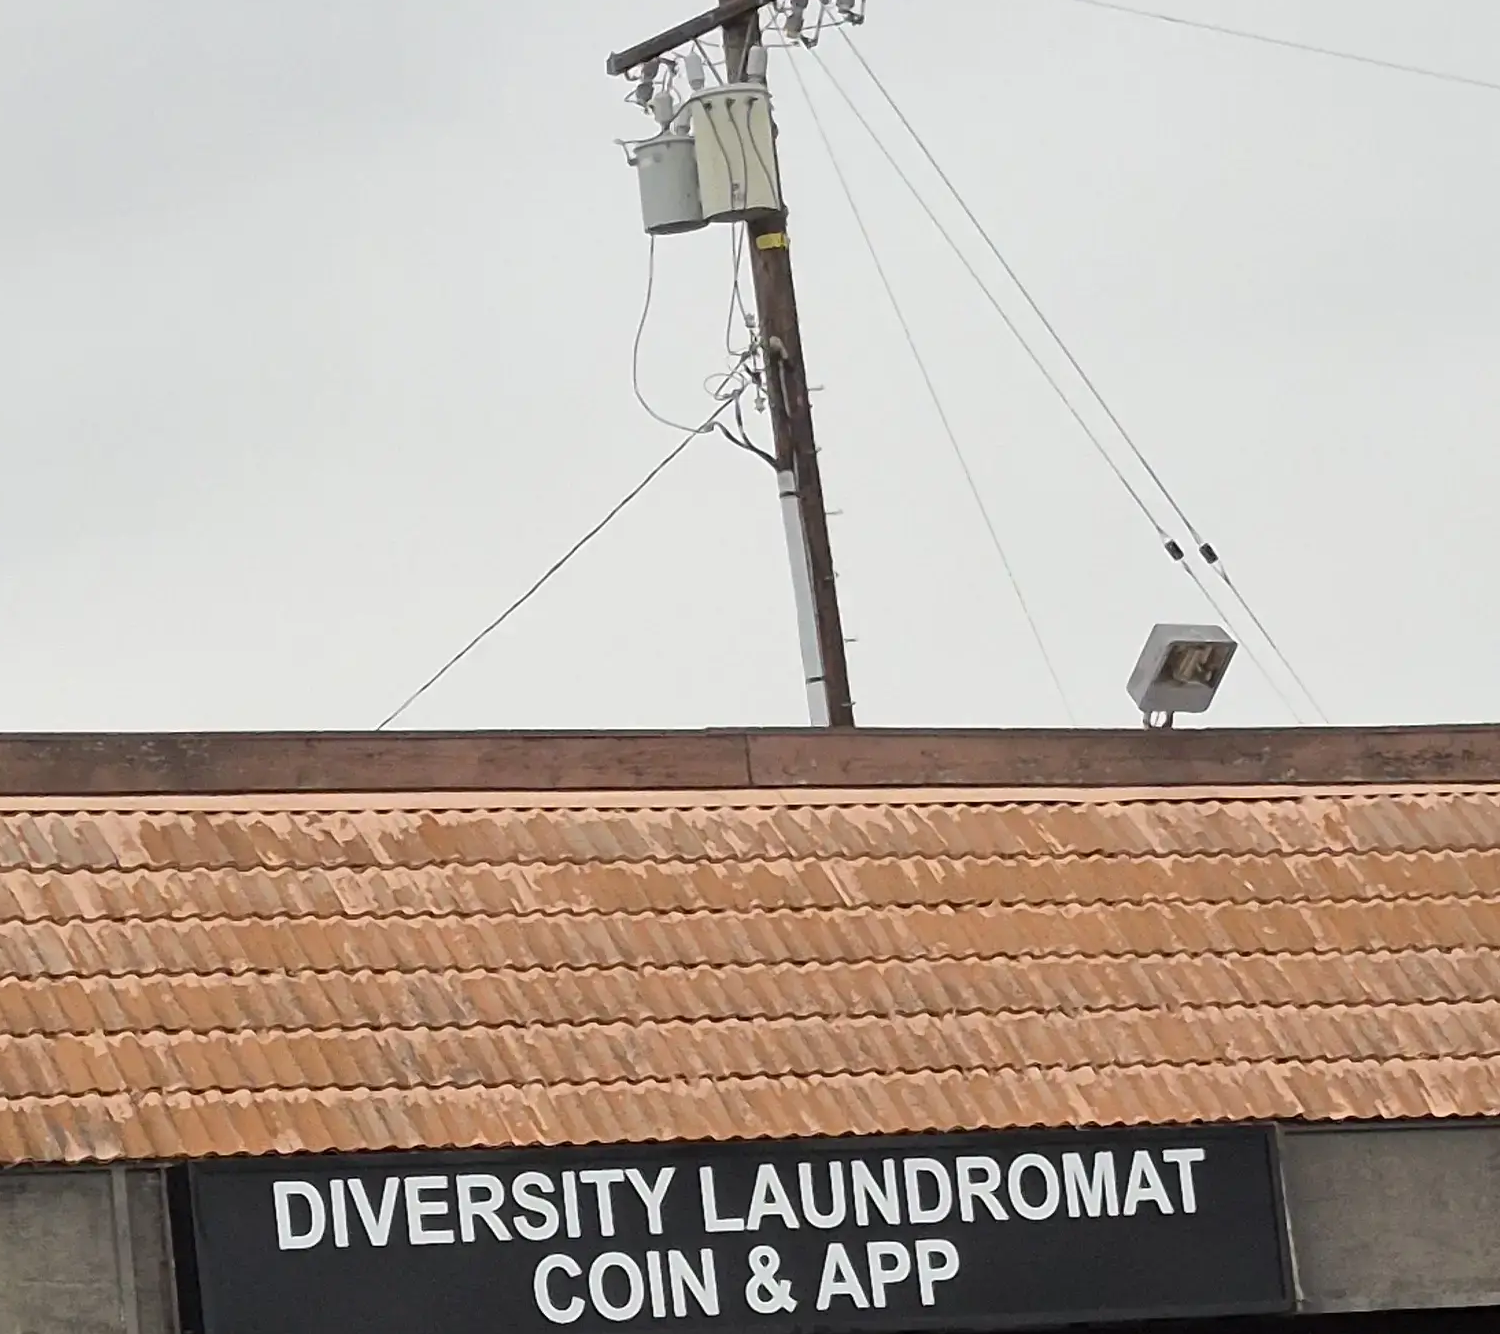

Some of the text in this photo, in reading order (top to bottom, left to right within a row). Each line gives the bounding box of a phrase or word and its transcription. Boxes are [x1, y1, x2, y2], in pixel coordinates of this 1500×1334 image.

[272, 1147, 1206, 1251] DIVERSITY LAUNDROMAT
[533, 1238, 960, 1325] COIN & APP
